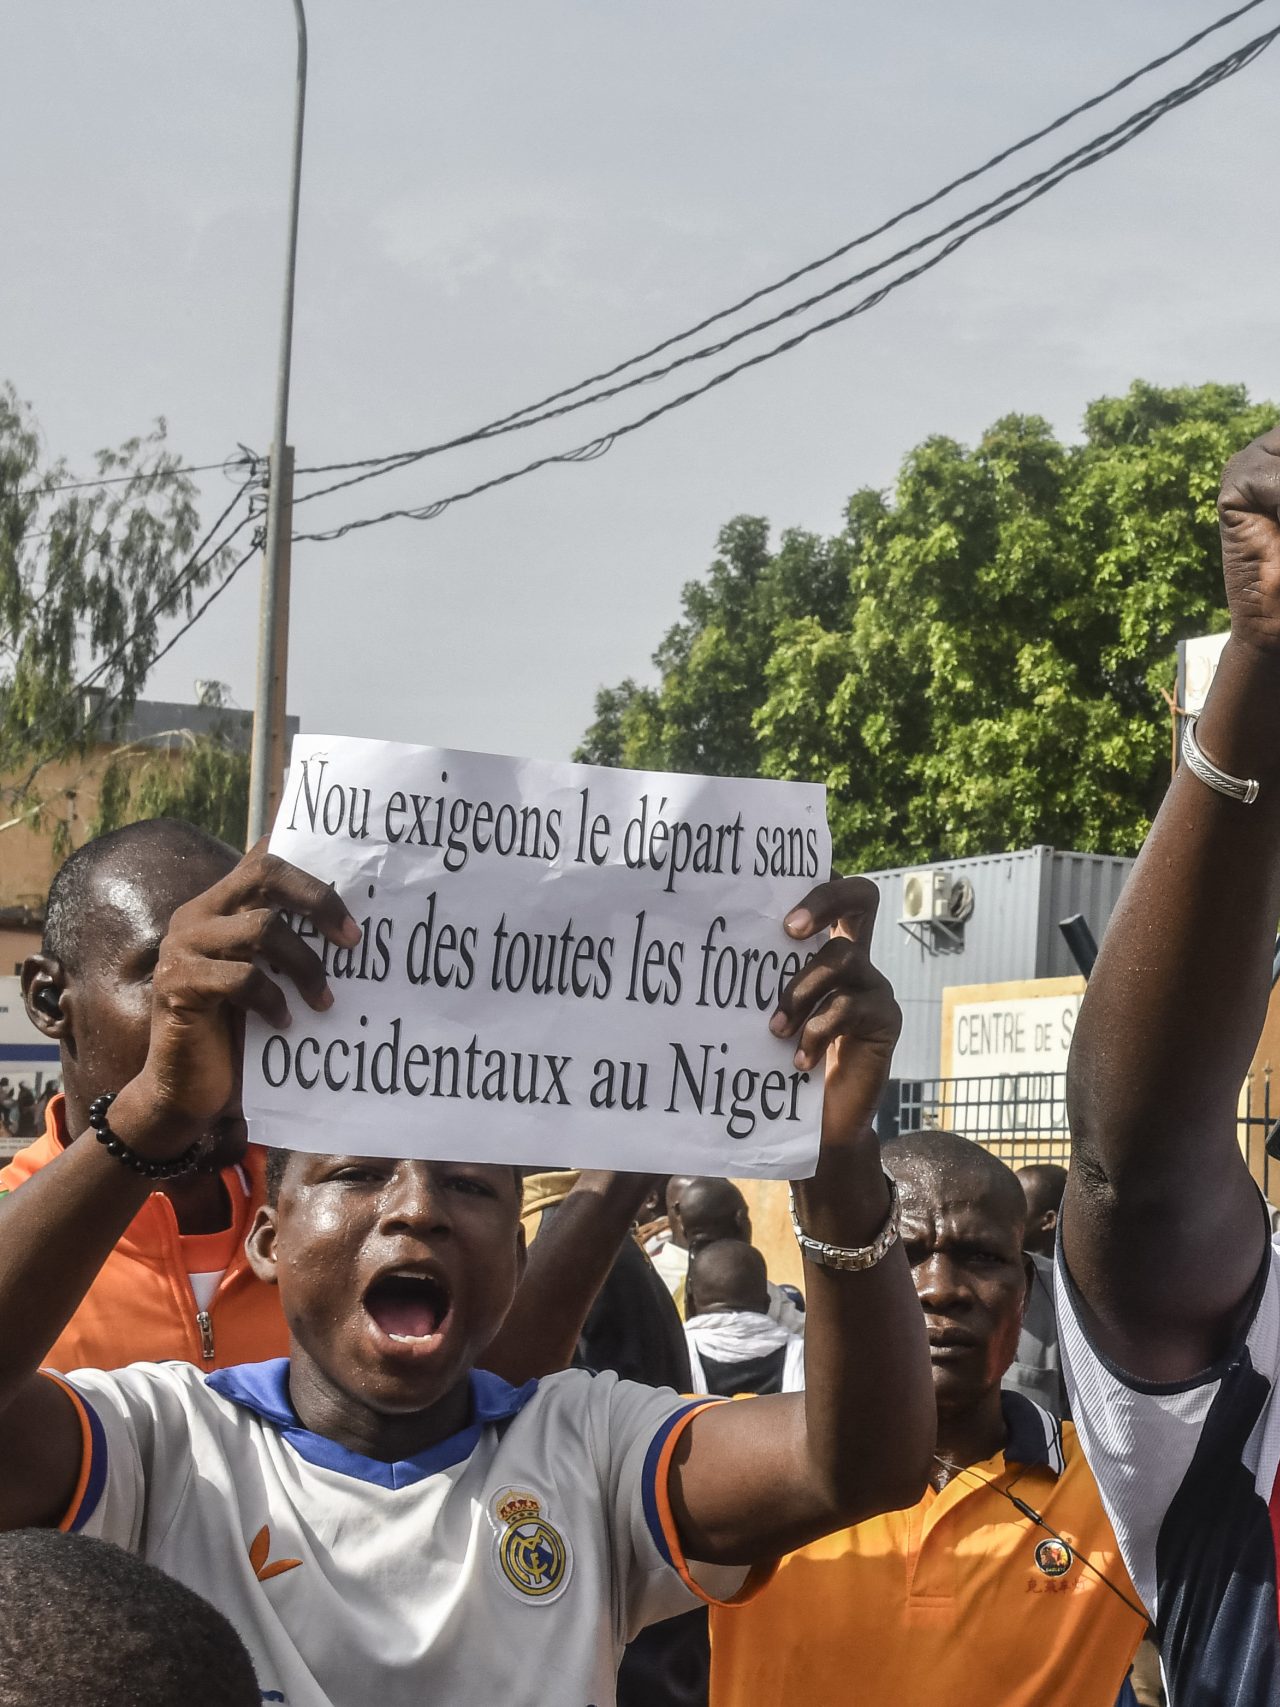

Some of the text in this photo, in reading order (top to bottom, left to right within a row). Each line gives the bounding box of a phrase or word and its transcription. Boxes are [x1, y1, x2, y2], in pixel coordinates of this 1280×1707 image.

[286, 759, 820, 893] Nou exigeons le départ sans
[406, 891, 478, 990] des
[491, 912, 615, 1000] toutes
[625, 910, 685, 1006] les
[695, 916, 817, 1012] force
[261, 1015, 811, 1139] occidentaux au Niger
[957, 1011, 1026, 1056] CENTRE
[1034, 1023, 1053, 1051] DE
